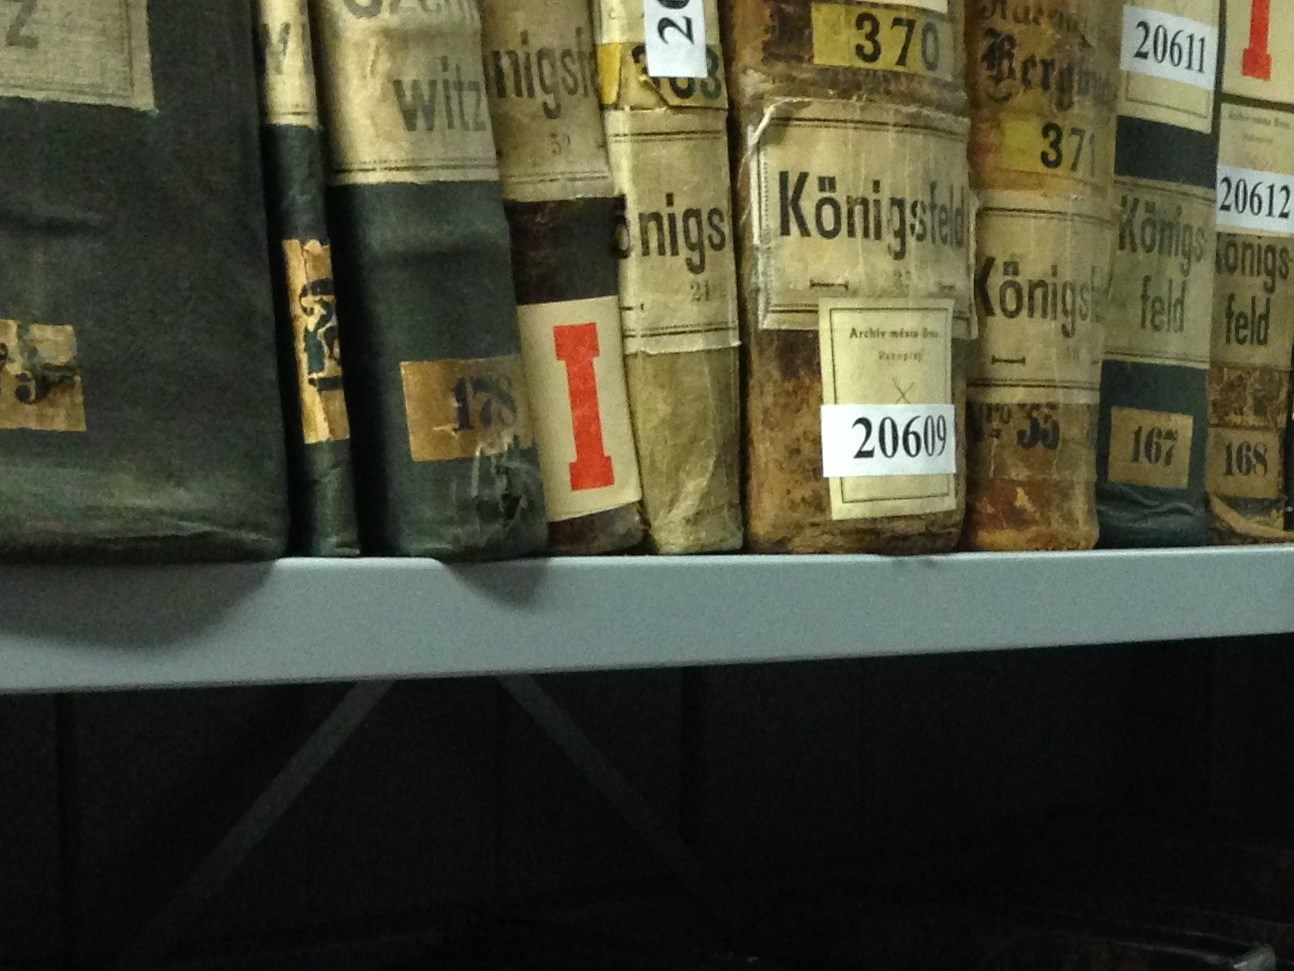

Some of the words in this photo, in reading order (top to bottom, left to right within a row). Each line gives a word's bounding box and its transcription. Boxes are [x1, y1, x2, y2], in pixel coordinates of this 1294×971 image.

[854, 11, 940, 72] 370
[1132, 20, 1207, 75] 20611
[391, 54, 488, 132] witz
[778, 169, 966, 262] Königsfeld
[1218, 175, 1292, 220] 20612
[1139, 274, 1189, 334] feld
[1223, 293, 1271, 347] feld
[553, 322, 616, 492] I
[851, 413, 948, 461] 20609
[1130, 424, 1179, 468] 167
[1221, 439, 1270, 479] 168
